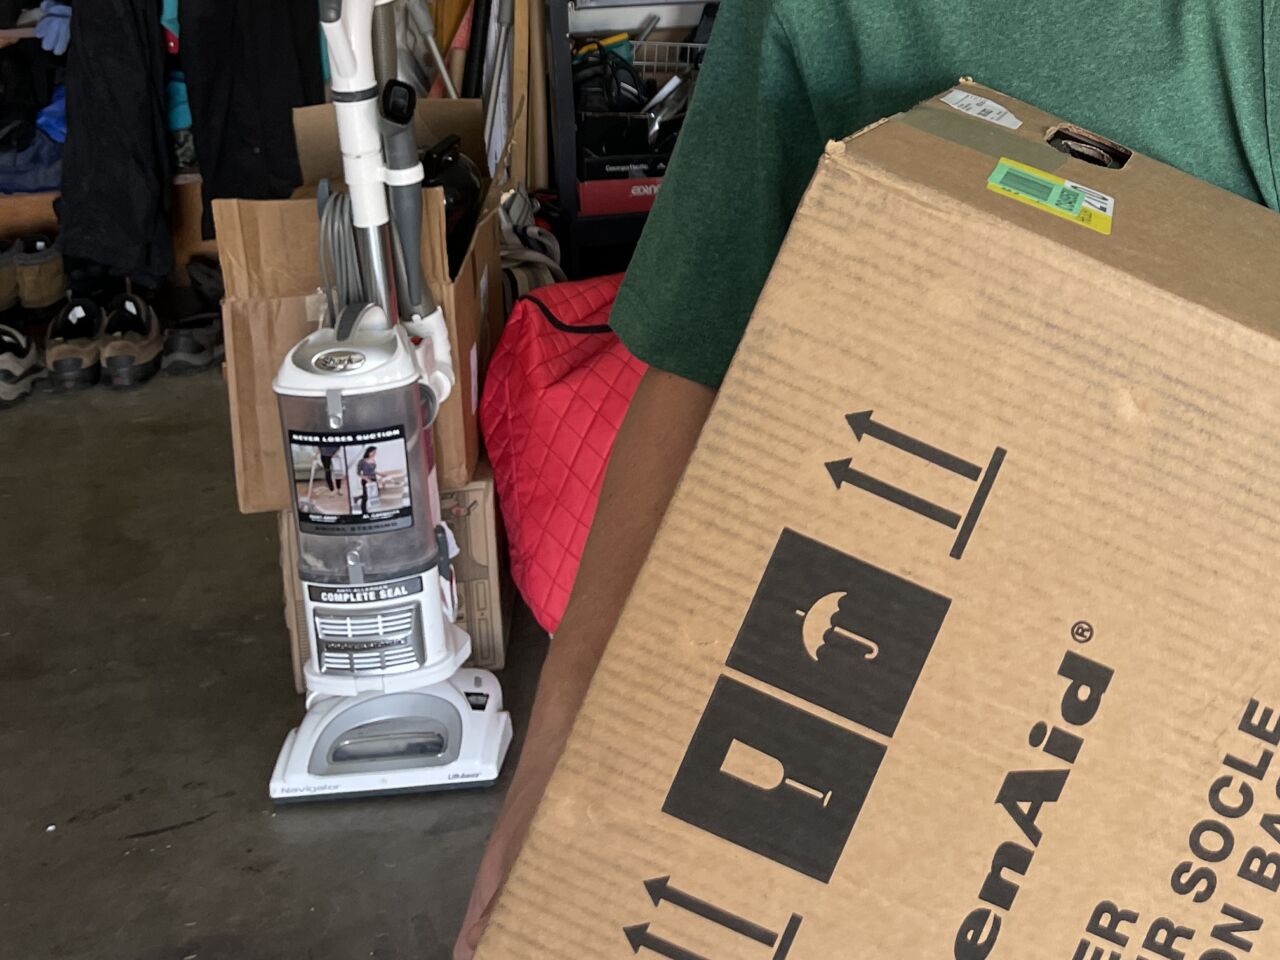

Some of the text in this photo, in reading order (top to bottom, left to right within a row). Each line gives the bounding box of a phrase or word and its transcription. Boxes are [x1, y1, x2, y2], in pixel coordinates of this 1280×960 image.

[356, 428, 400, 440] SUCTION
[321, 586, 408, 602] COMPLETE SEAL
[281, 783, 341, 794] Navigator
[1199, 903, 1264, 960] N
